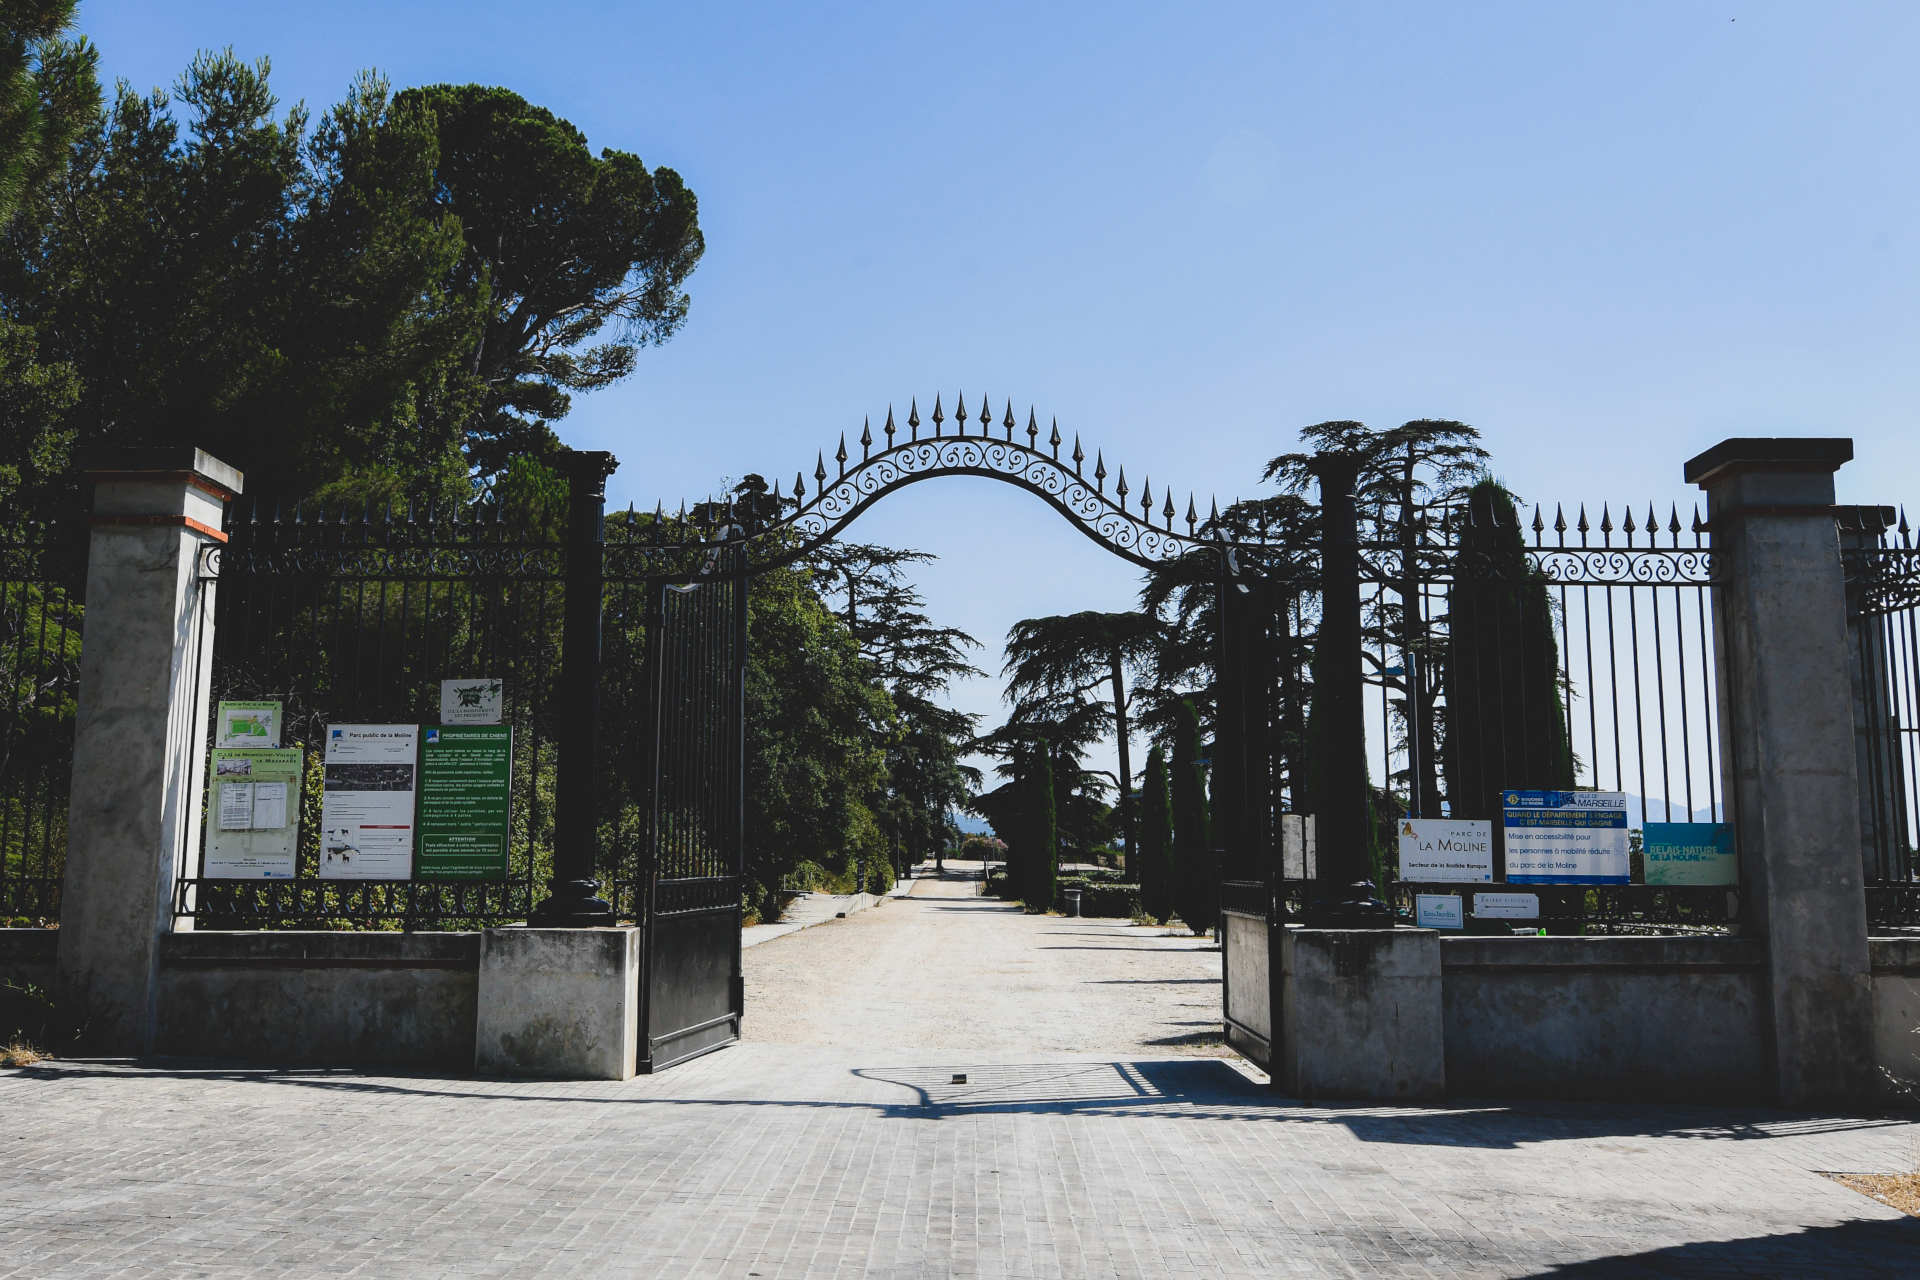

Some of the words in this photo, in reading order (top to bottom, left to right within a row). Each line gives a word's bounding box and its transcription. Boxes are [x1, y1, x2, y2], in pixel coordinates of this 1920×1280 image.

[1577, 799, 1625, 808] MARSEILLE
[1506, 811, 1532, 819] QUAND
[1533, 811, 1541, 819] LE
[1419, 841, 1433, 851] LA
[1437, 838, 1487, 852] MOLINE
[1519, 848, 1553, 856] personnes
[1650, 845, 1718, 855] RELAIS-NATURE
[1423, 910, 1456, 918] EcoJardin
